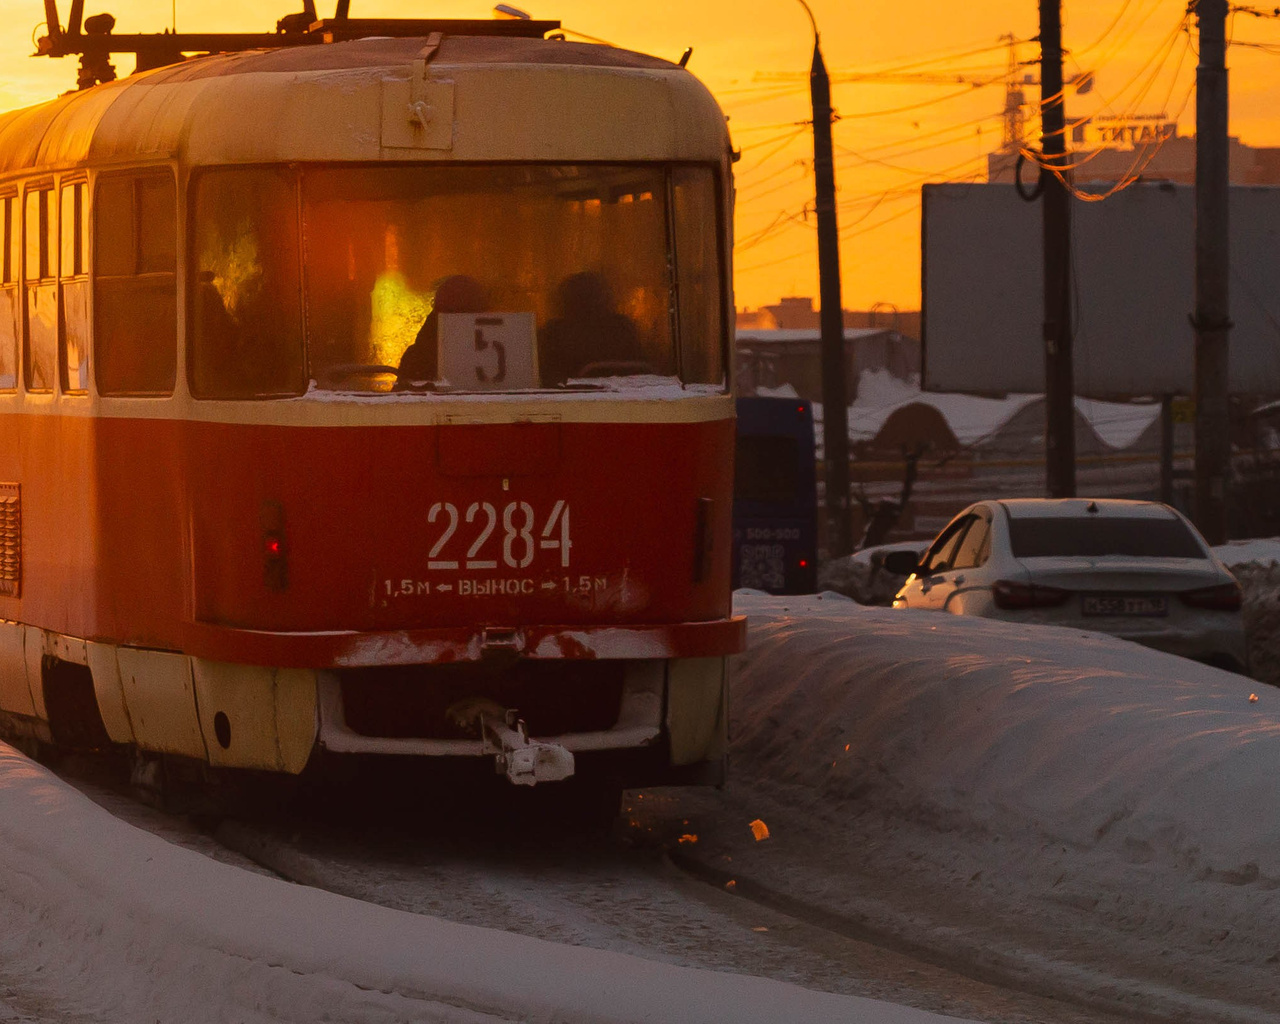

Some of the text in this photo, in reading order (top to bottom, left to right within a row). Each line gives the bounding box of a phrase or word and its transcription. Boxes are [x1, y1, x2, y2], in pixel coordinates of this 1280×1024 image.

[1097, 125, 1165, 143] ТИТАН
[474, 317, 506, 384] 5
[427, 499, 573, 570] 2284
[458, 578, 535, 596] ВЫНОС
